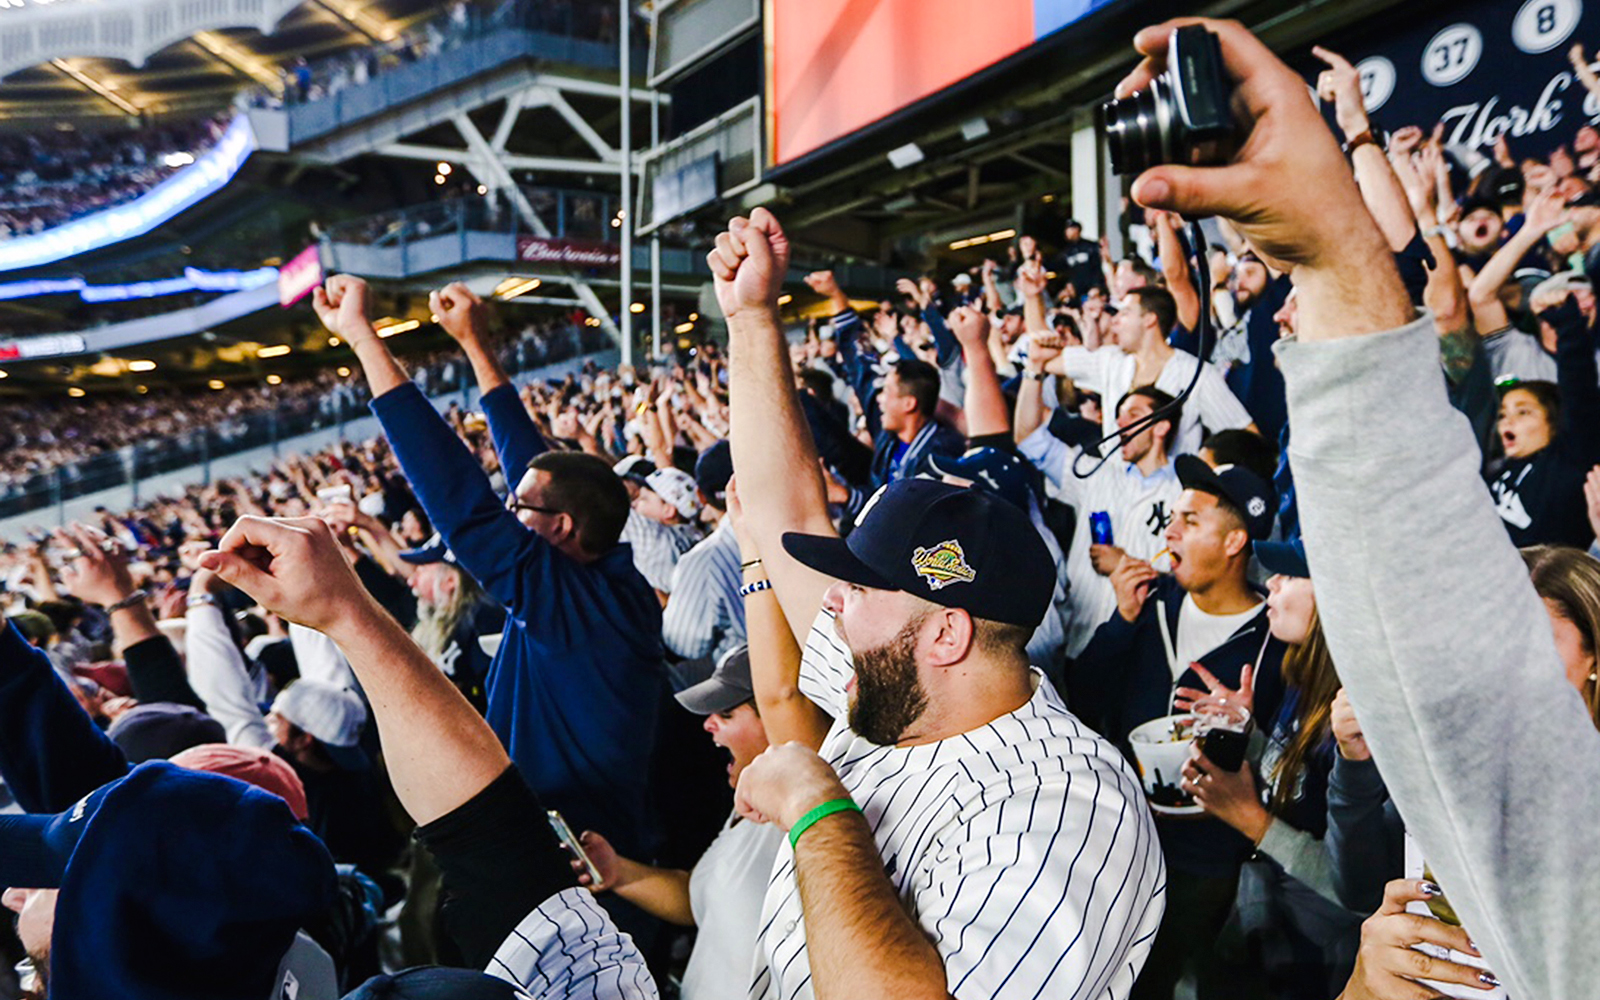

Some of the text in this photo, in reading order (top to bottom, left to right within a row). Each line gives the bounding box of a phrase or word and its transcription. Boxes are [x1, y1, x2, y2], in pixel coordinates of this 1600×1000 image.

[1537, 6, 1555, 34] 8
[1434, 37, 1470, 73] 37
[1440, 71, 1572, 151] York
